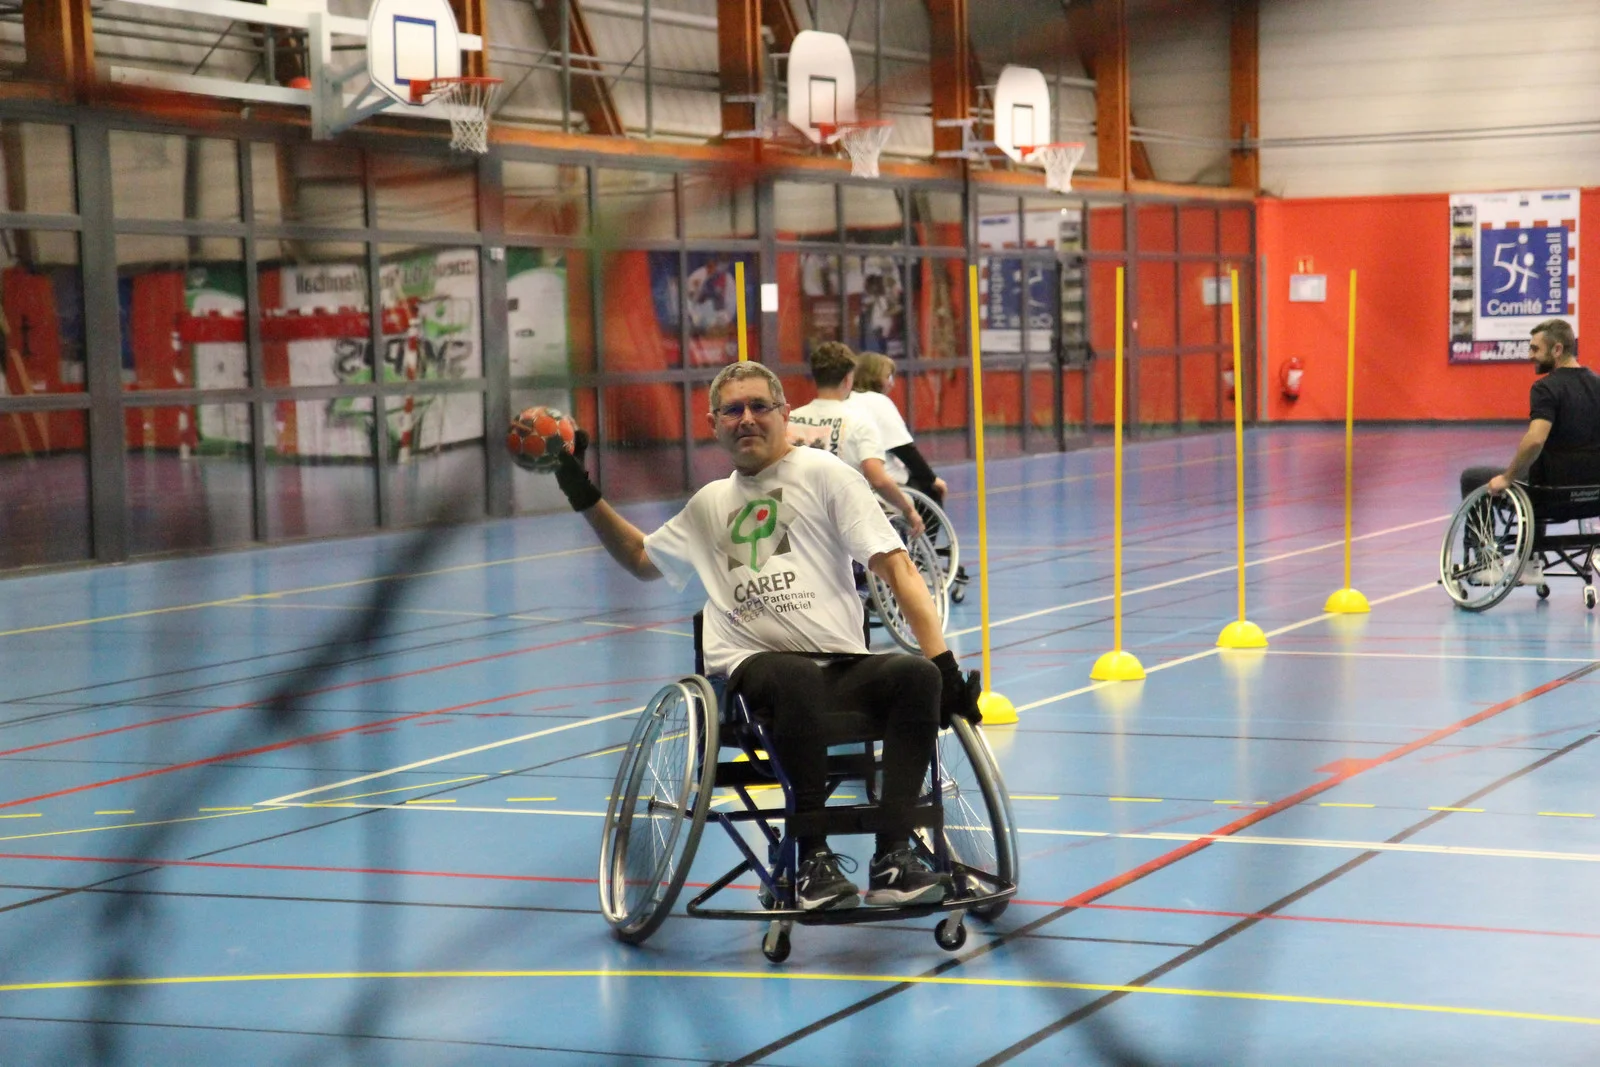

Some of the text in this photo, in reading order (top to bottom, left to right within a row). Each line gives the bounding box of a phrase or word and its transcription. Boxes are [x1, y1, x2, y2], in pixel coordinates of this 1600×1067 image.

[1545, 232, 1562, 313] Handball
[1487, 298, 1542, 316] Comité
[734, 571, 796, 603] CAREP
[763, 590, 815, 604] Partenaire
[775, 601, 812, 613] Officiel
